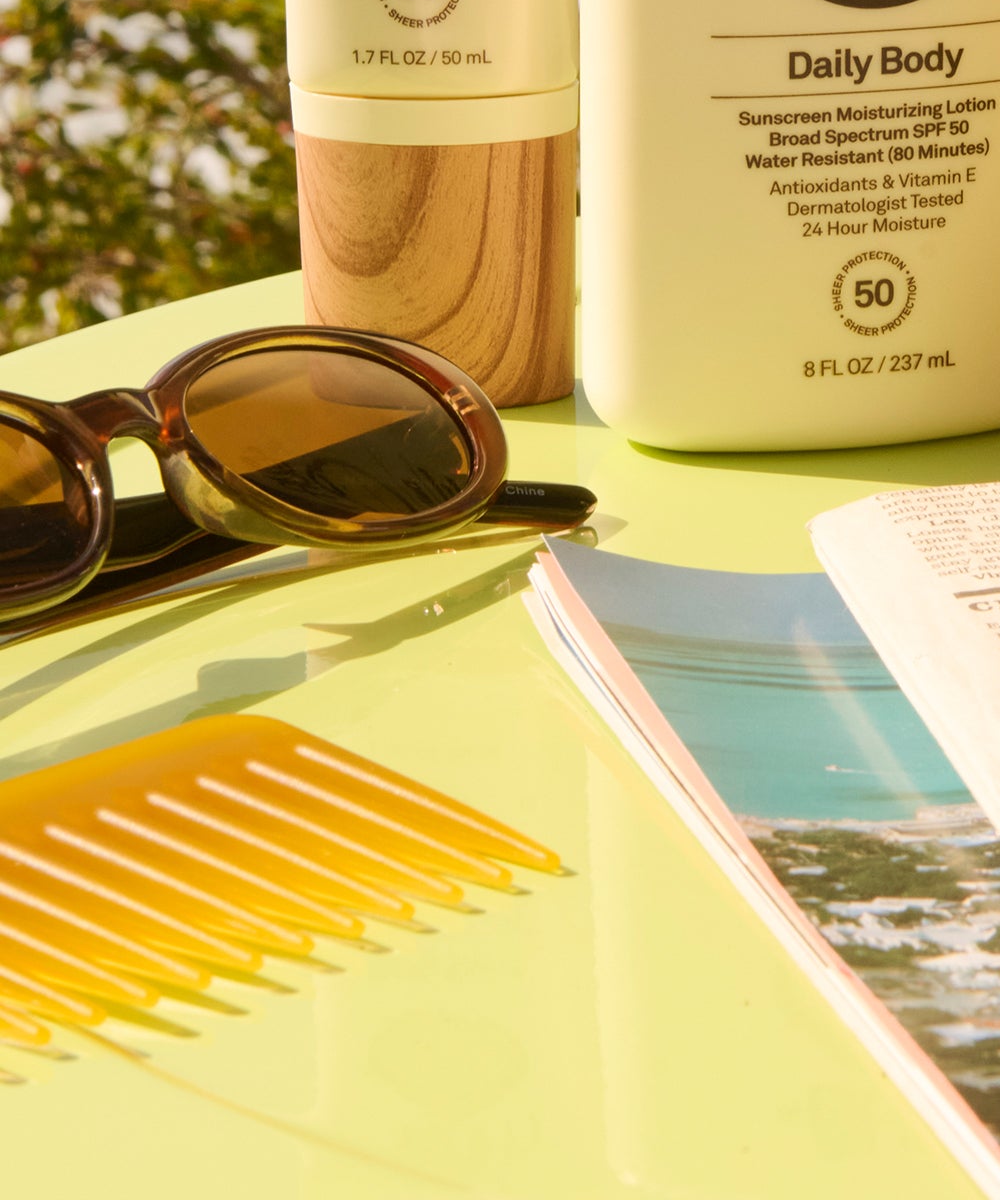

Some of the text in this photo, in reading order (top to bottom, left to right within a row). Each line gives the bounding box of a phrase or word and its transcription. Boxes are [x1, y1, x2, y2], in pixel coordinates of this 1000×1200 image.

[388, 8, 424, 28] SHEER
[353, 50, 491, 65] 1.7 FL OZ / 50 mL
[789, 42, 964, 84] Daily Body
[739, 97, 996, 126] Sunscreen Moisturizing Lotion
[770, 120, 969, 147] Broad Spectrum SPF 50
[746, 138, 989, 168] Water Resistant (80 Minutes)
[770, 167, 976, 195] Antioxidants & Vitamin E
[788, 190, 963, 219] Dermatologist Tested
[803, 217, 946, 237] 24 Hour Moisture
[832, 250, 907, 312] SHEER PROTECTION
[855, 279, 894, 308] 50
[843, 276, 917, 336] SHEER PROTECTION
[804, 350, 955, 377] 8 FL OZ / 237 mL
[505, 484, 545, 497] Chine
